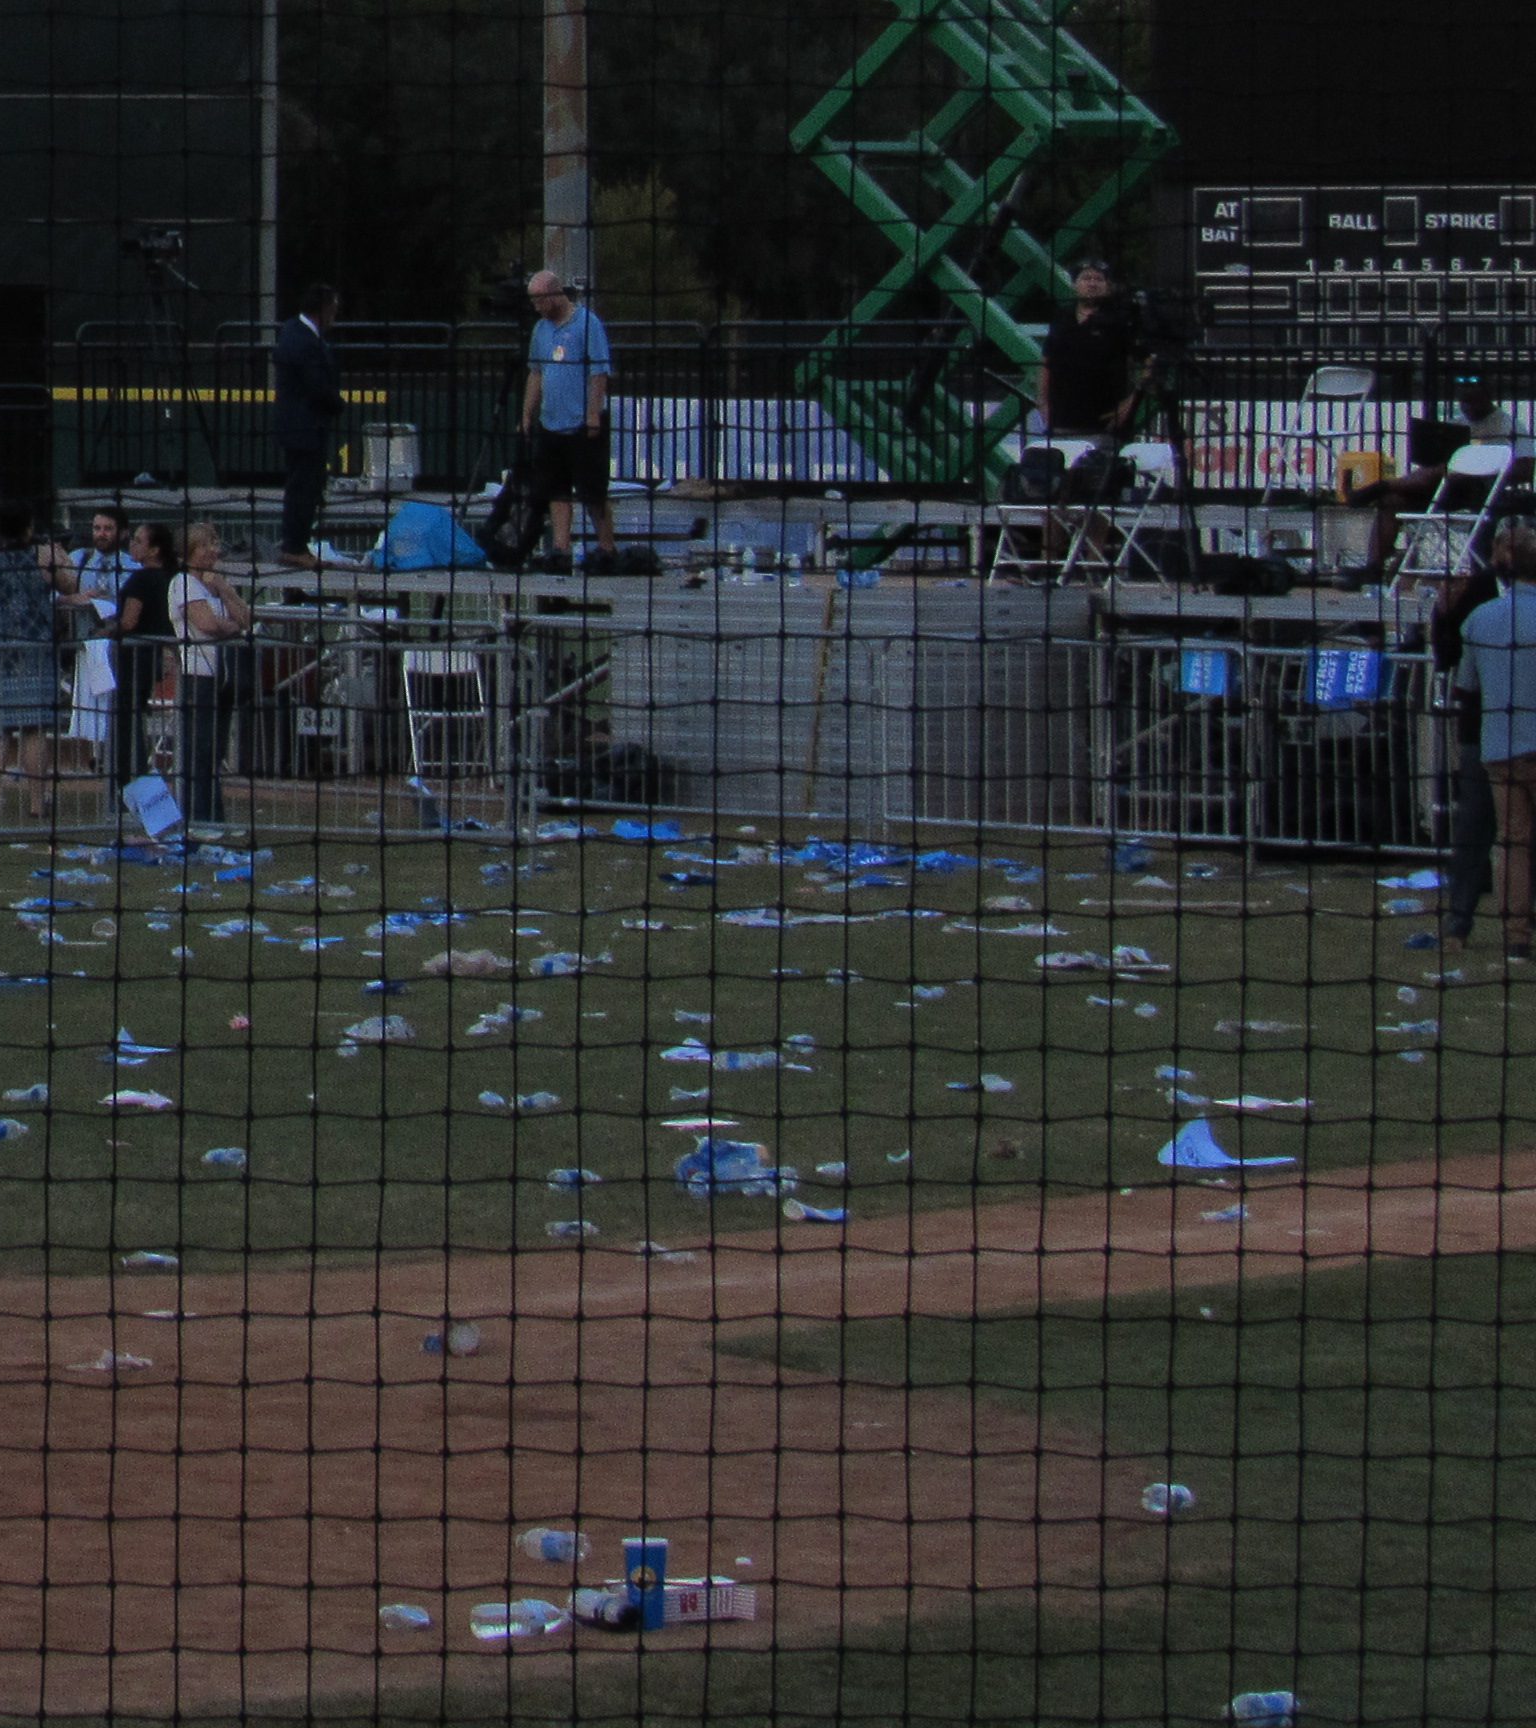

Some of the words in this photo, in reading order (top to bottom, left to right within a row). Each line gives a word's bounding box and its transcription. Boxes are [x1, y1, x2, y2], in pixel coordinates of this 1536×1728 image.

[1213, 201, 1240, 219] AT
[1328, 213, 1378, 231] BALL
[1424, 212, 1498, 230] STRIKE
[1201, 226, 1240, 243] BAT
[1305, 258, 1316, 272] 1
[1332, 258, 1346, 272] 2
[1362, 258, 1375, 272] 3
[1392, 258, 1405, 272] 4
[1420, 258, 1434, 272] 5
[1450, 257, 1462, 272] 6
[1480, 257, 1493, 272] 7
